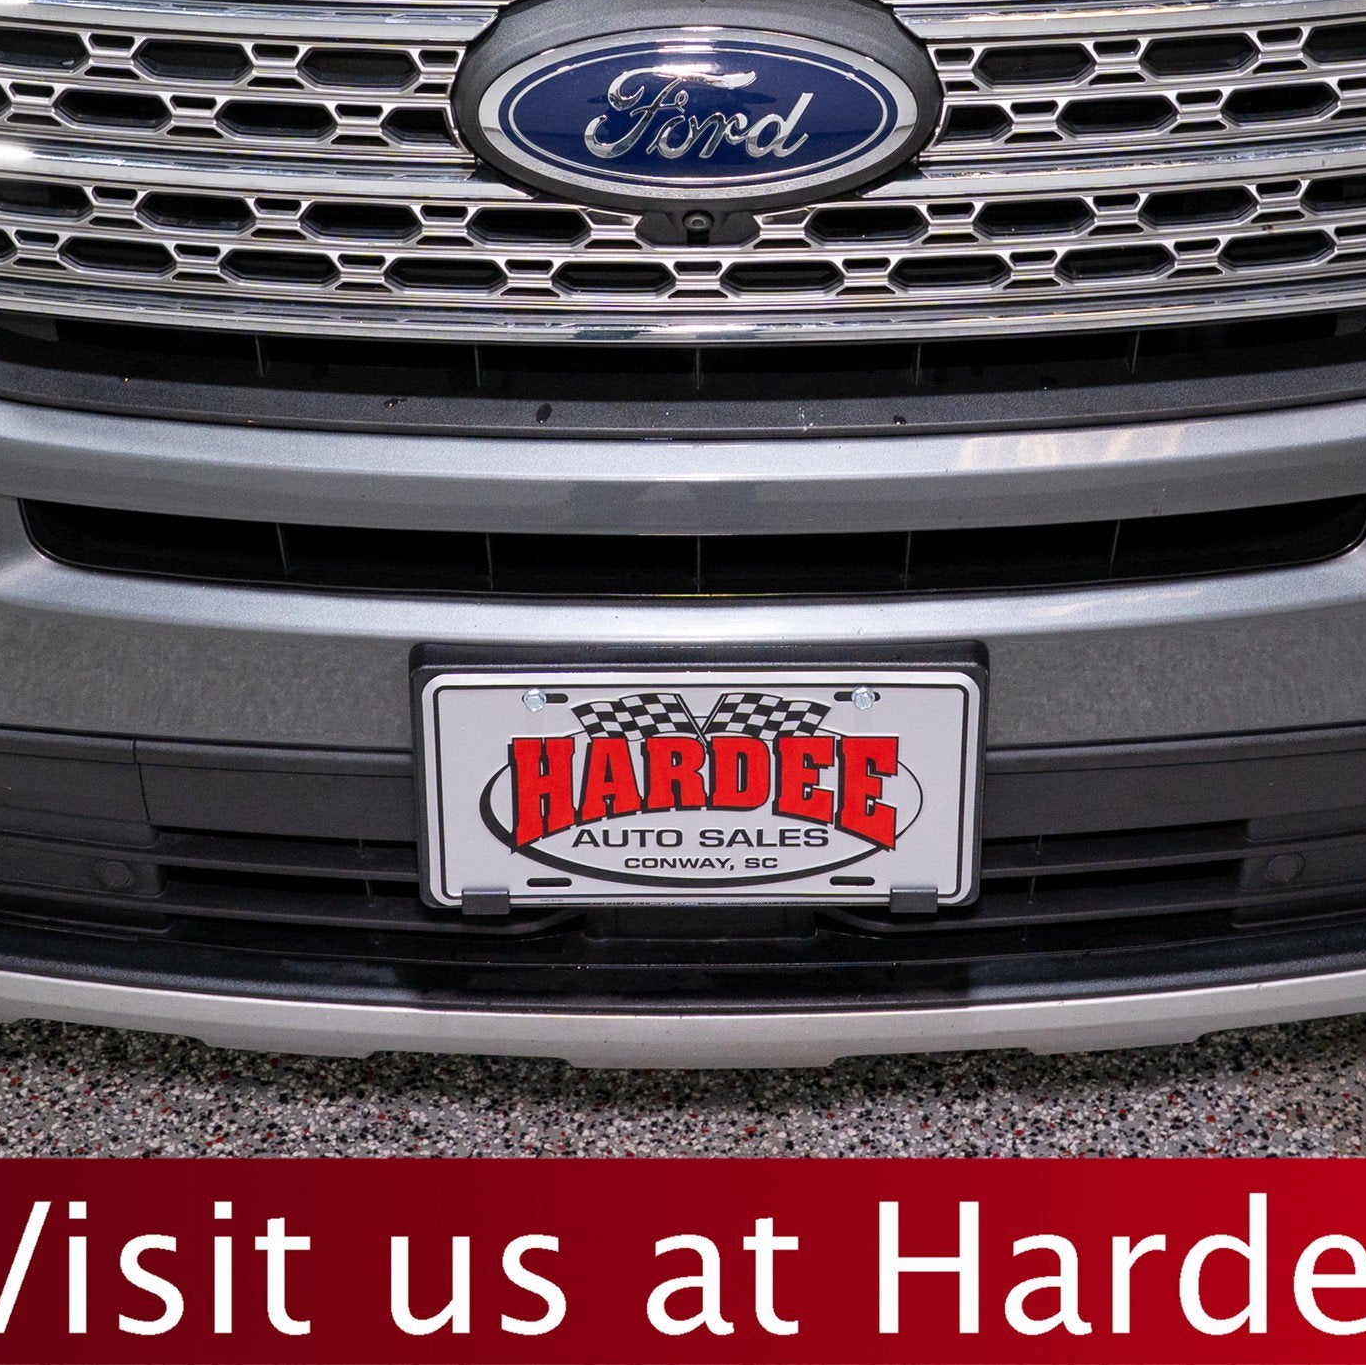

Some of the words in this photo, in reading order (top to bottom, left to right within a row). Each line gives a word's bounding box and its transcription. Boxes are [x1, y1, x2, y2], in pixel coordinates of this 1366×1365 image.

[584, 65, 814, 160] Ford
[508, 736, 899, 853] HARDEE
[572, 828, 684, 849] AUTO
[698, 828, 830, 849] SALES
[623, 856, 736, 872] CONWAY,
[743, 856, 779, 870] SC
